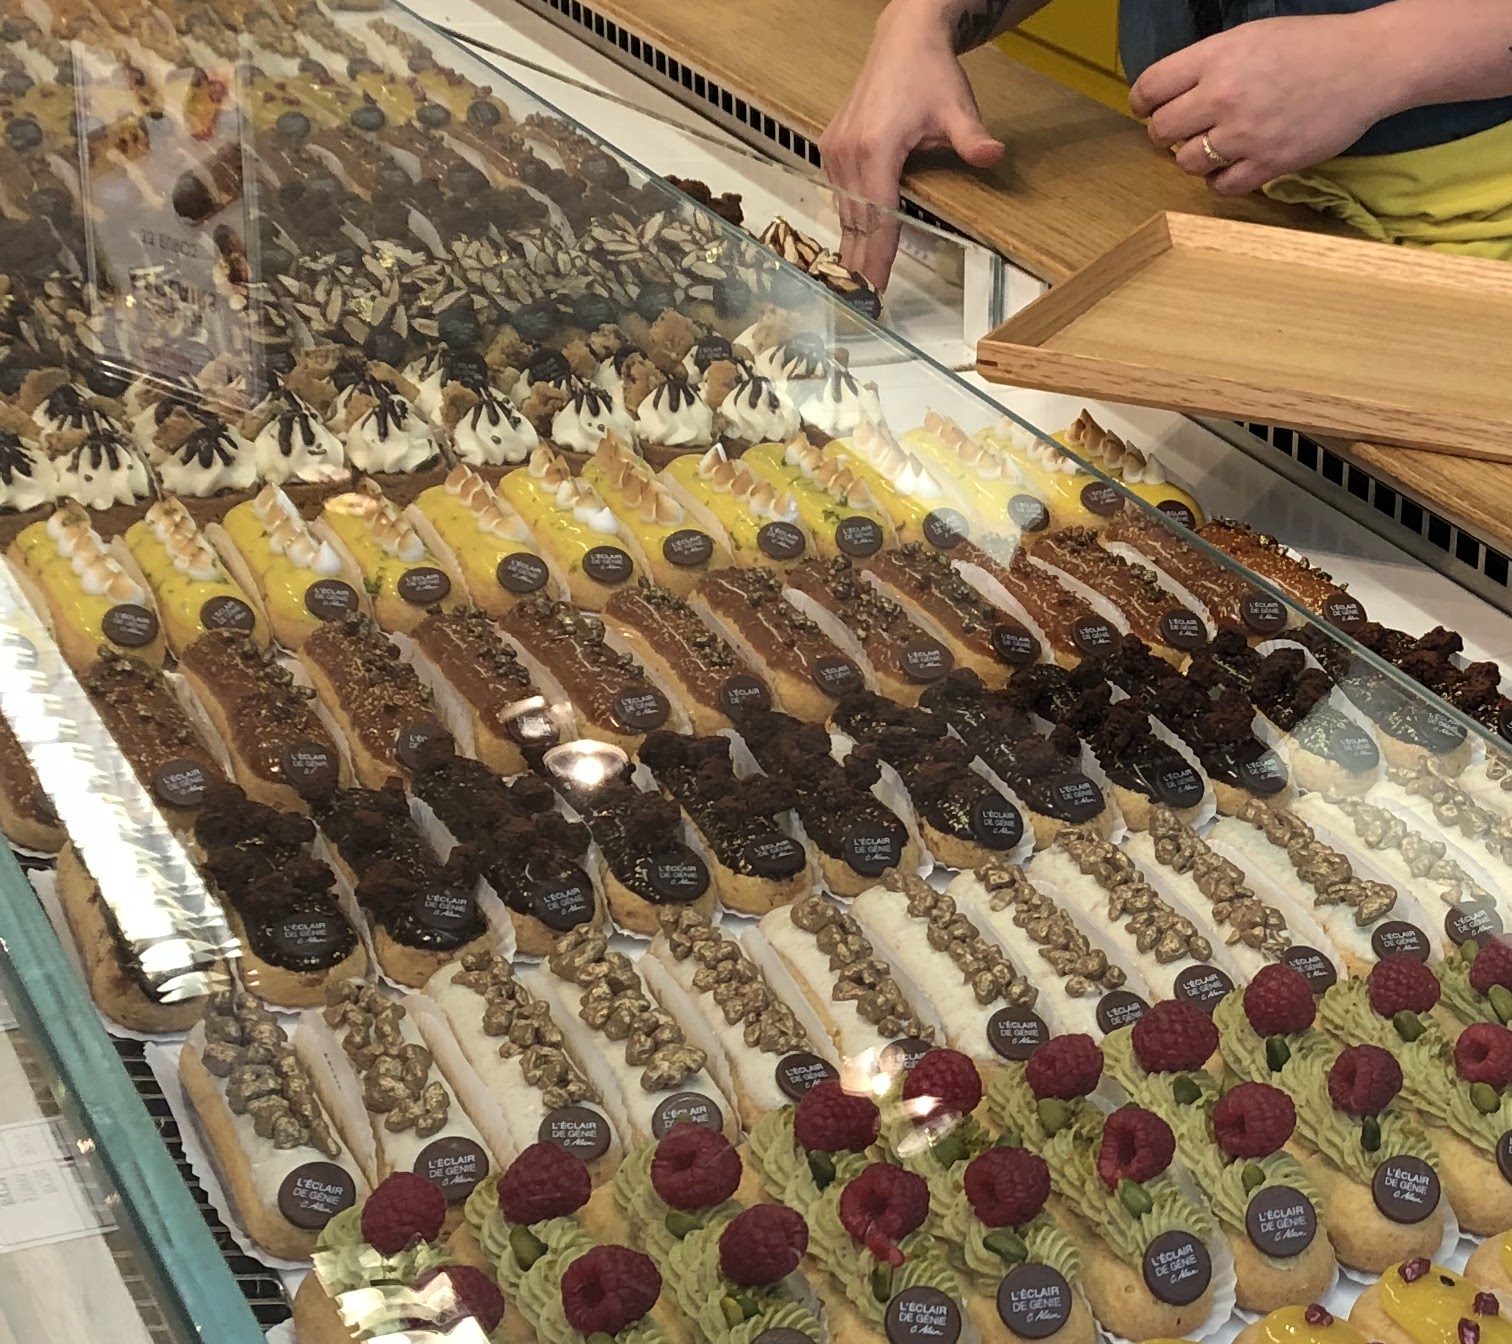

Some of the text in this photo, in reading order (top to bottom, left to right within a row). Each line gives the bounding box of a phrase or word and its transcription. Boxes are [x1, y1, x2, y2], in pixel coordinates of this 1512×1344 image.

[1186, 988, 1199, 997] DE
[428, 1168, 444, 1177] DE
[1386, 1167, 1430, 1184] L'ÉCLAIR
[1383, 1177, 1398, 1187] DE
[292, 1188, 307, 1199] DE
[1258, 1204, 1304, 1220] L'ÉCLAIR
[1260, 1220, 1275, 1230] DE
[1150, 1244, 1194, 1266] L'ÉCLAIR
[1154, 1264, 1169, 1275] DE
[1011, 1286, 1059, 1299] L'ÉCLAIR
[900, 1301, 947, 1315] L'ÉCLAIR
[1011, 1302, 1027, 1312] DE
[897, 1313, 913, 1323] DE
